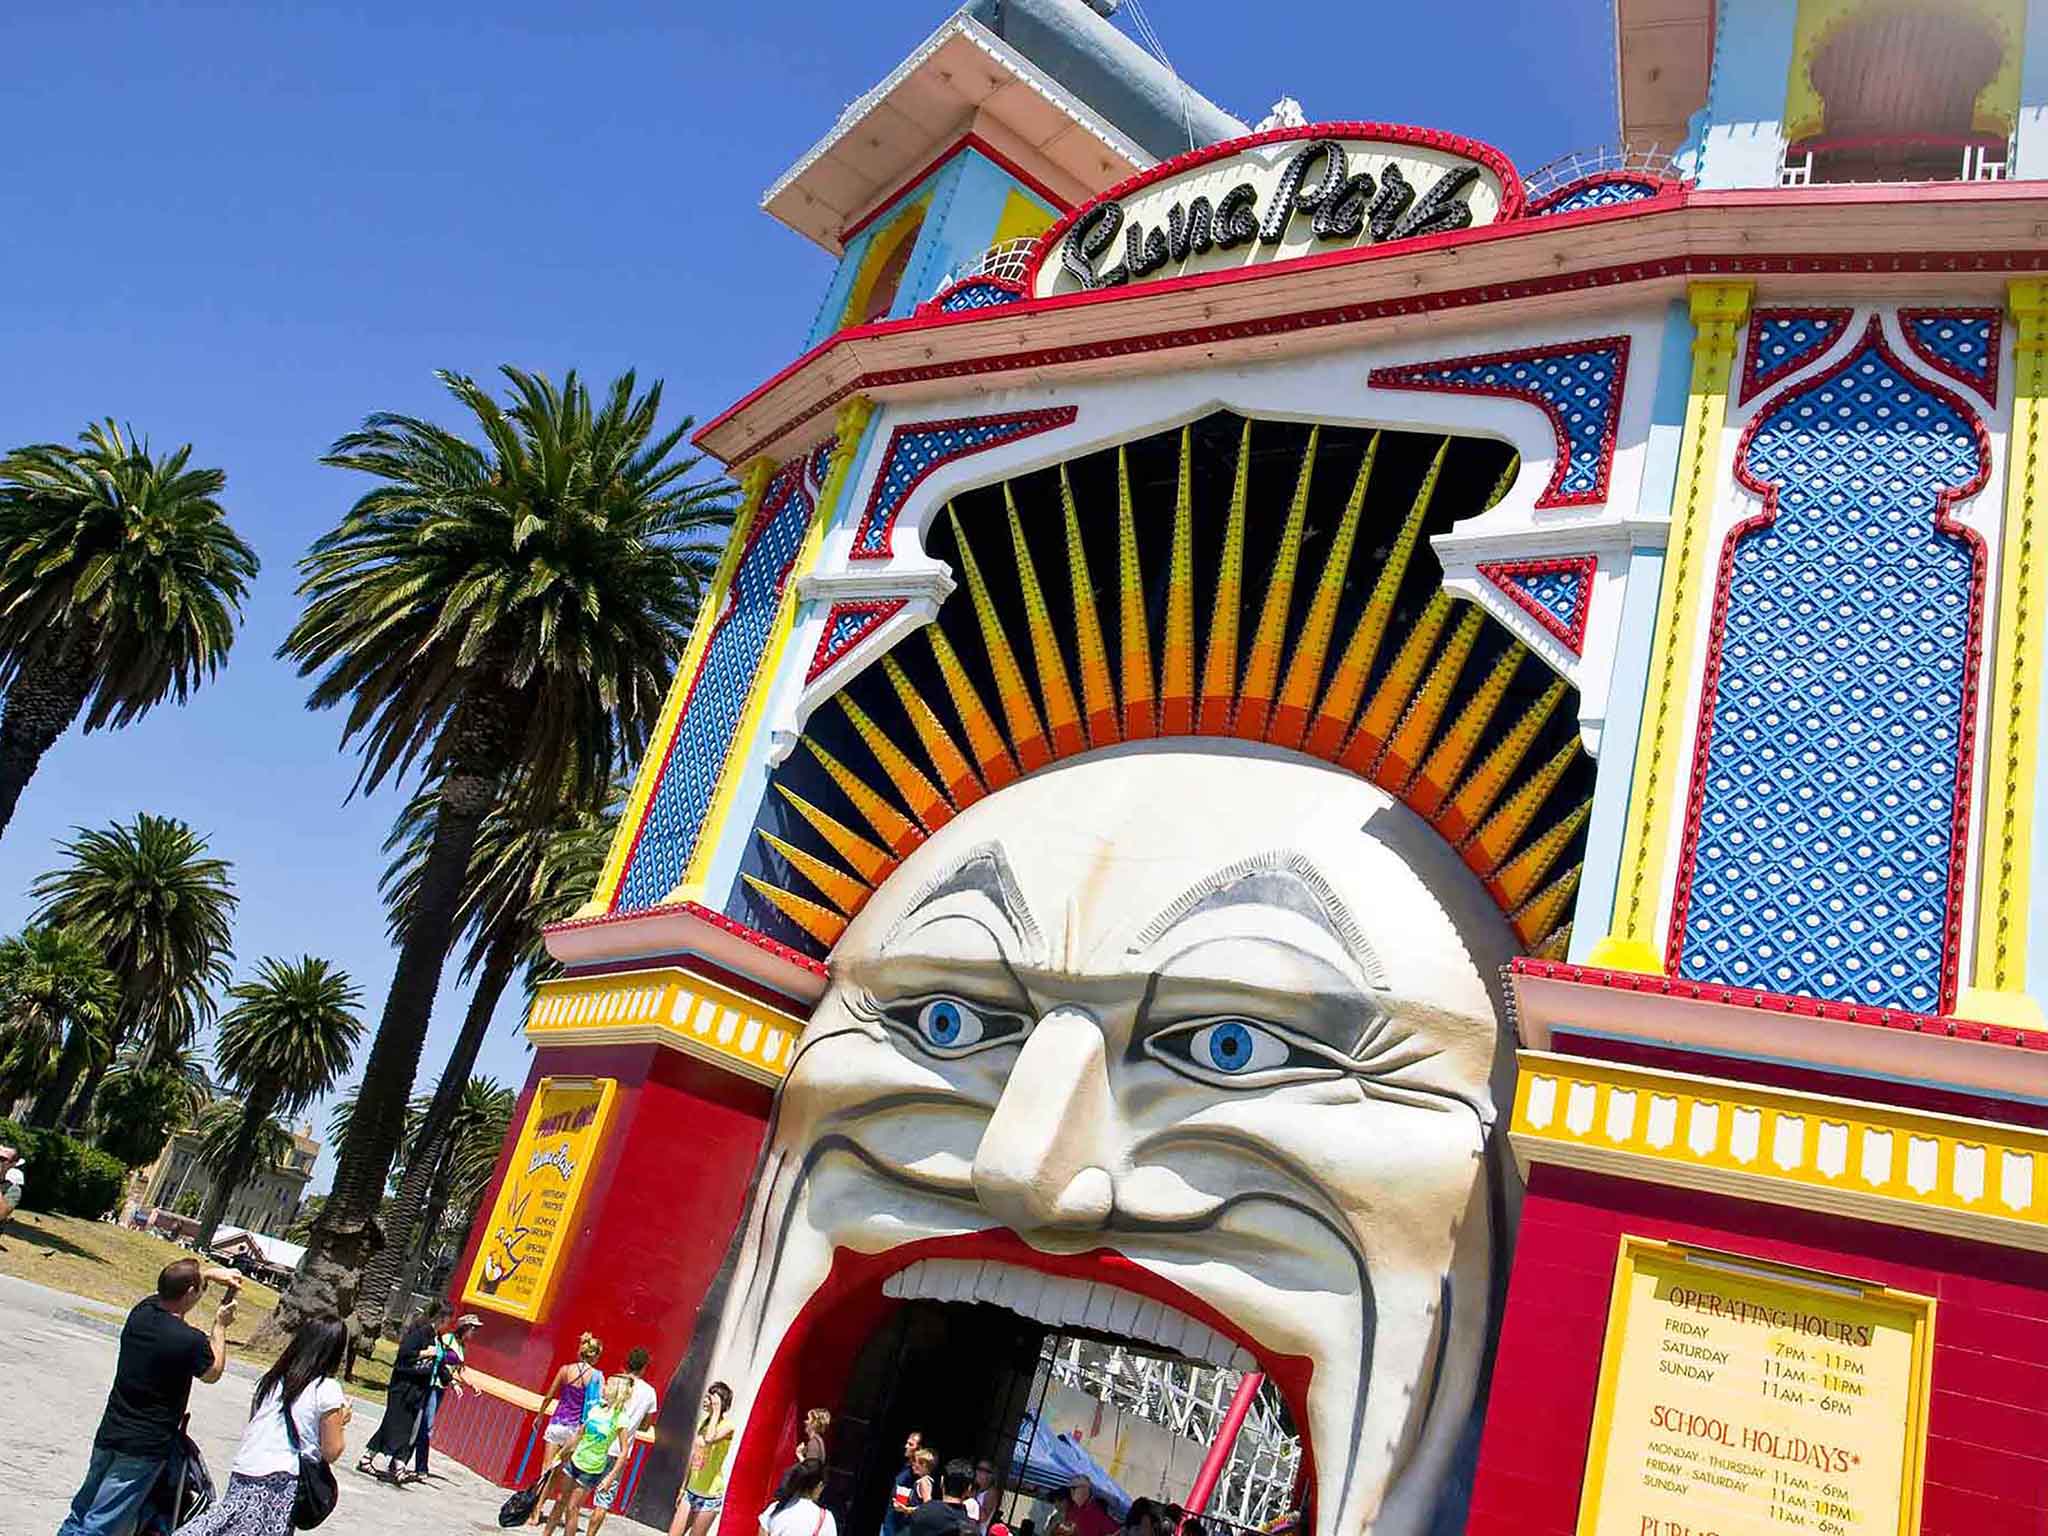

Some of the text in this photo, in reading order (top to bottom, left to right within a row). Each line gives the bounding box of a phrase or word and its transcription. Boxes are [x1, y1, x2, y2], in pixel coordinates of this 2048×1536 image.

[1061, 139, 1481, 289] Luna Park
[1669, 1286, 1872, 1347] OPERATING HOURS
[1661, 1339, 1729, 1365] SATURDAY
[1765, 1359, 1806, 1383] 11AM
[1823, 1374, 1863, 1396] 11PM
[1664, 1318, 1710, 1339] FRIDAY
[1775, 1343, 1806, 1361] 7PM
[1825, 1352, 1864, 1375] 11PM
[1658, 1359, 1715, 1383] SUNDAY
[1762, 1381, 1803, 1405] 11AM
[1820, 1396, 1852, 1416] 6PM
[1650, 1405, 1736, 1447] SCHOOL
[1645, 1457, 1682, 1476] FRIDAY
[1691, 1470, 1749, 1493] SATURDAY
[1772, 1488, 1807, 1508] 11AM
[1648, 1441, 1700, 1463] MONDAY
[1709, 1455, 1766, 1480] THURSDAY
[1774, 1470, 1809, 1491] 11AM
[1822, 1483, 1849, 1500] 6PM
[1640, 1515, 1720, 1536] PUB
[1642, 1475, 1689, 1496] SUNDAY
[1770, 1505, 1805, 1525] 11AM
[1818, 1518, 1846, 1536] 6PM
